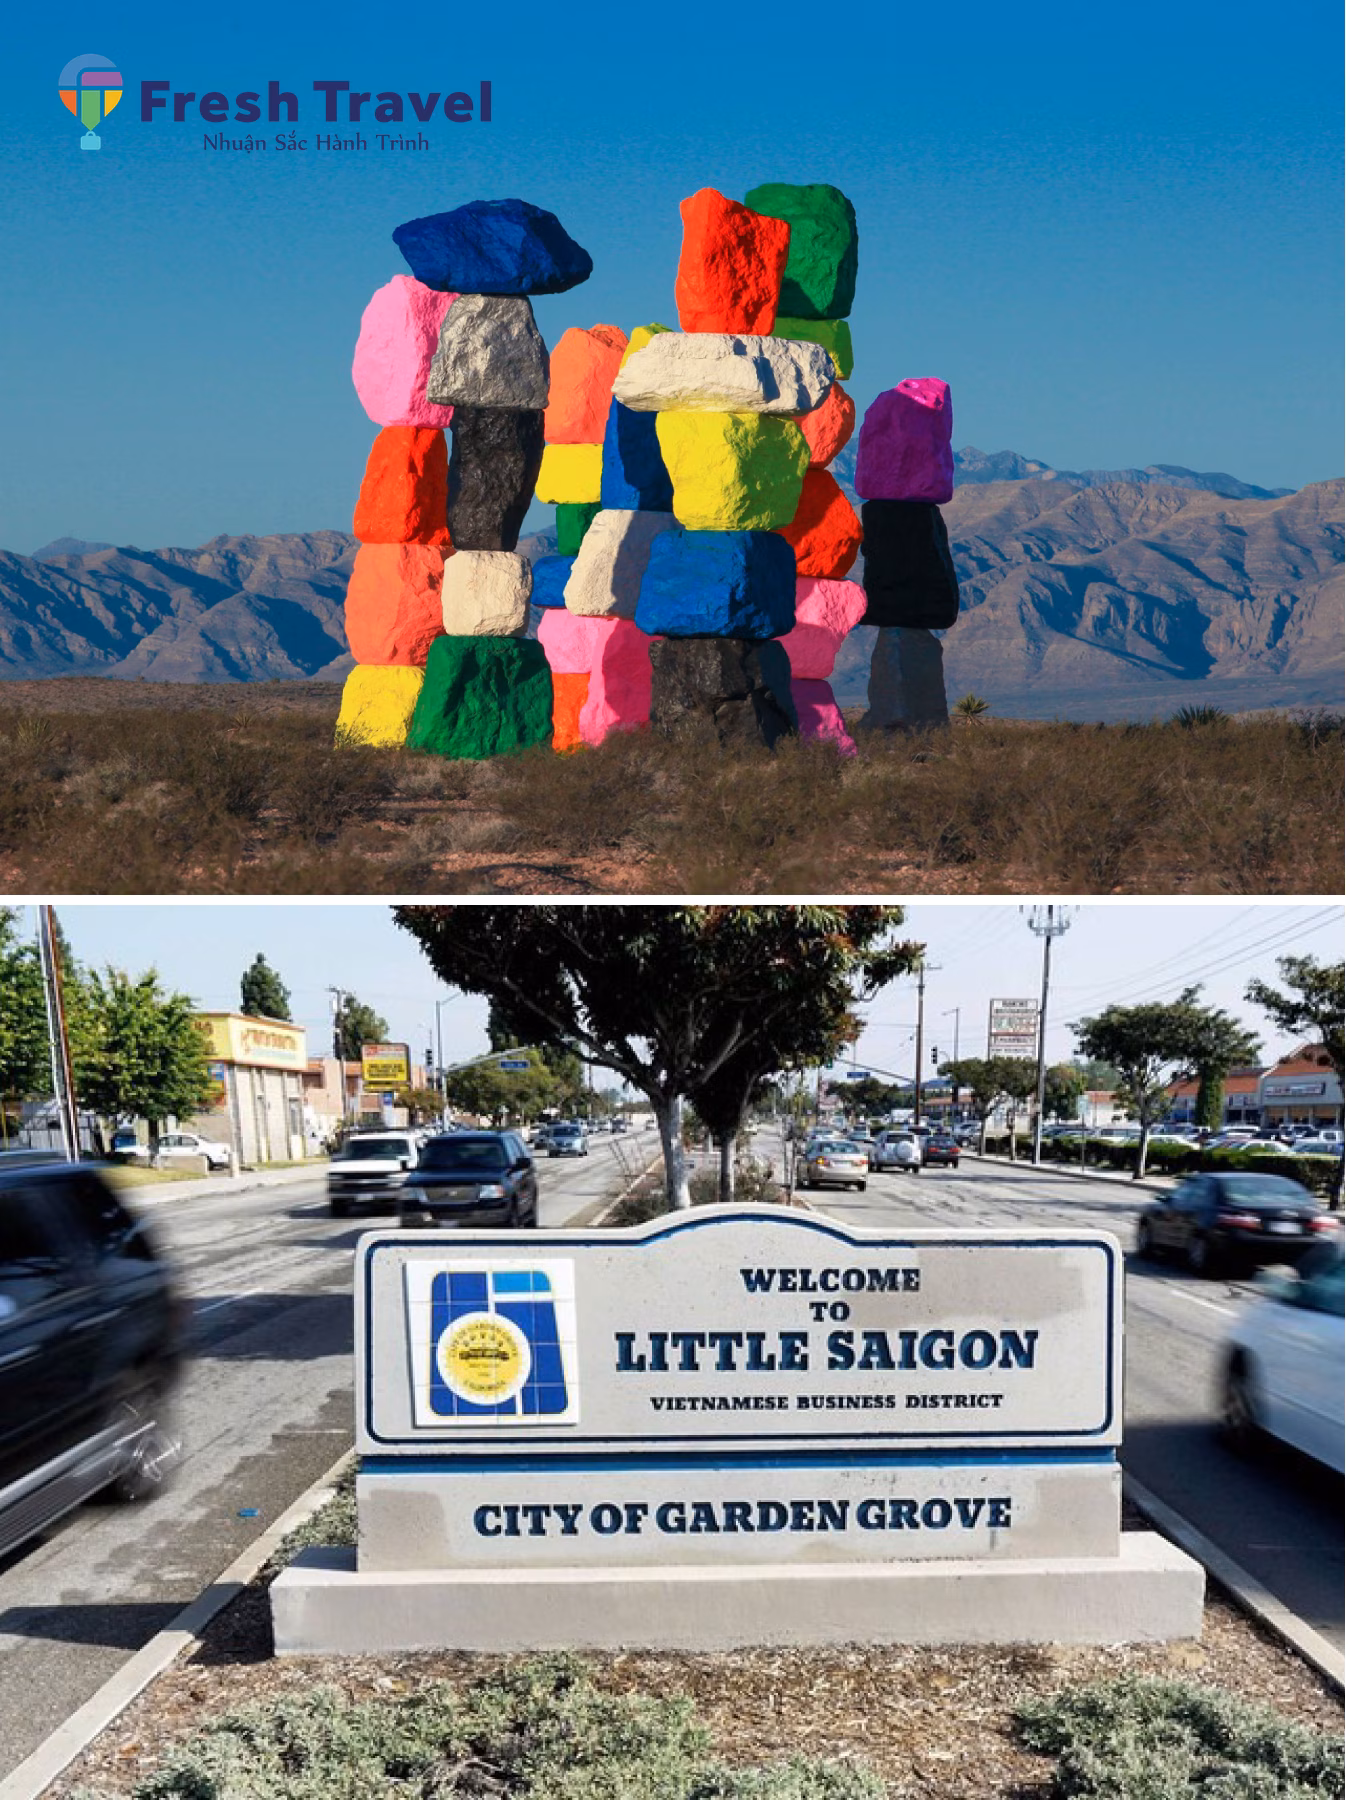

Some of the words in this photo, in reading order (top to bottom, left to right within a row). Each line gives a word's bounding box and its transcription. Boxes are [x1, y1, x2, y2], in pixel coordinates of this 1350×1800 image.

[740, 1269, 920, 1293] WELCOME
[809, 1301, 850, 1323] TO
[615, 1331, 809, 1373] LITTLE
[827, 1329, 1039, 1371] SAIGON
[649, 1395, 789, 1411] VIETNAMESE
[796, 1394, 896, 1410] BUSINESS
[904, 1393, 1004, 1409] DISTRICT
[473, 1503, 584, 1537] CITY
[590, 1503, 649, 1535] OF
[655, 1499, 850, 1535] GARDEN
[856, 1497, 1012, 1531] GROVE
